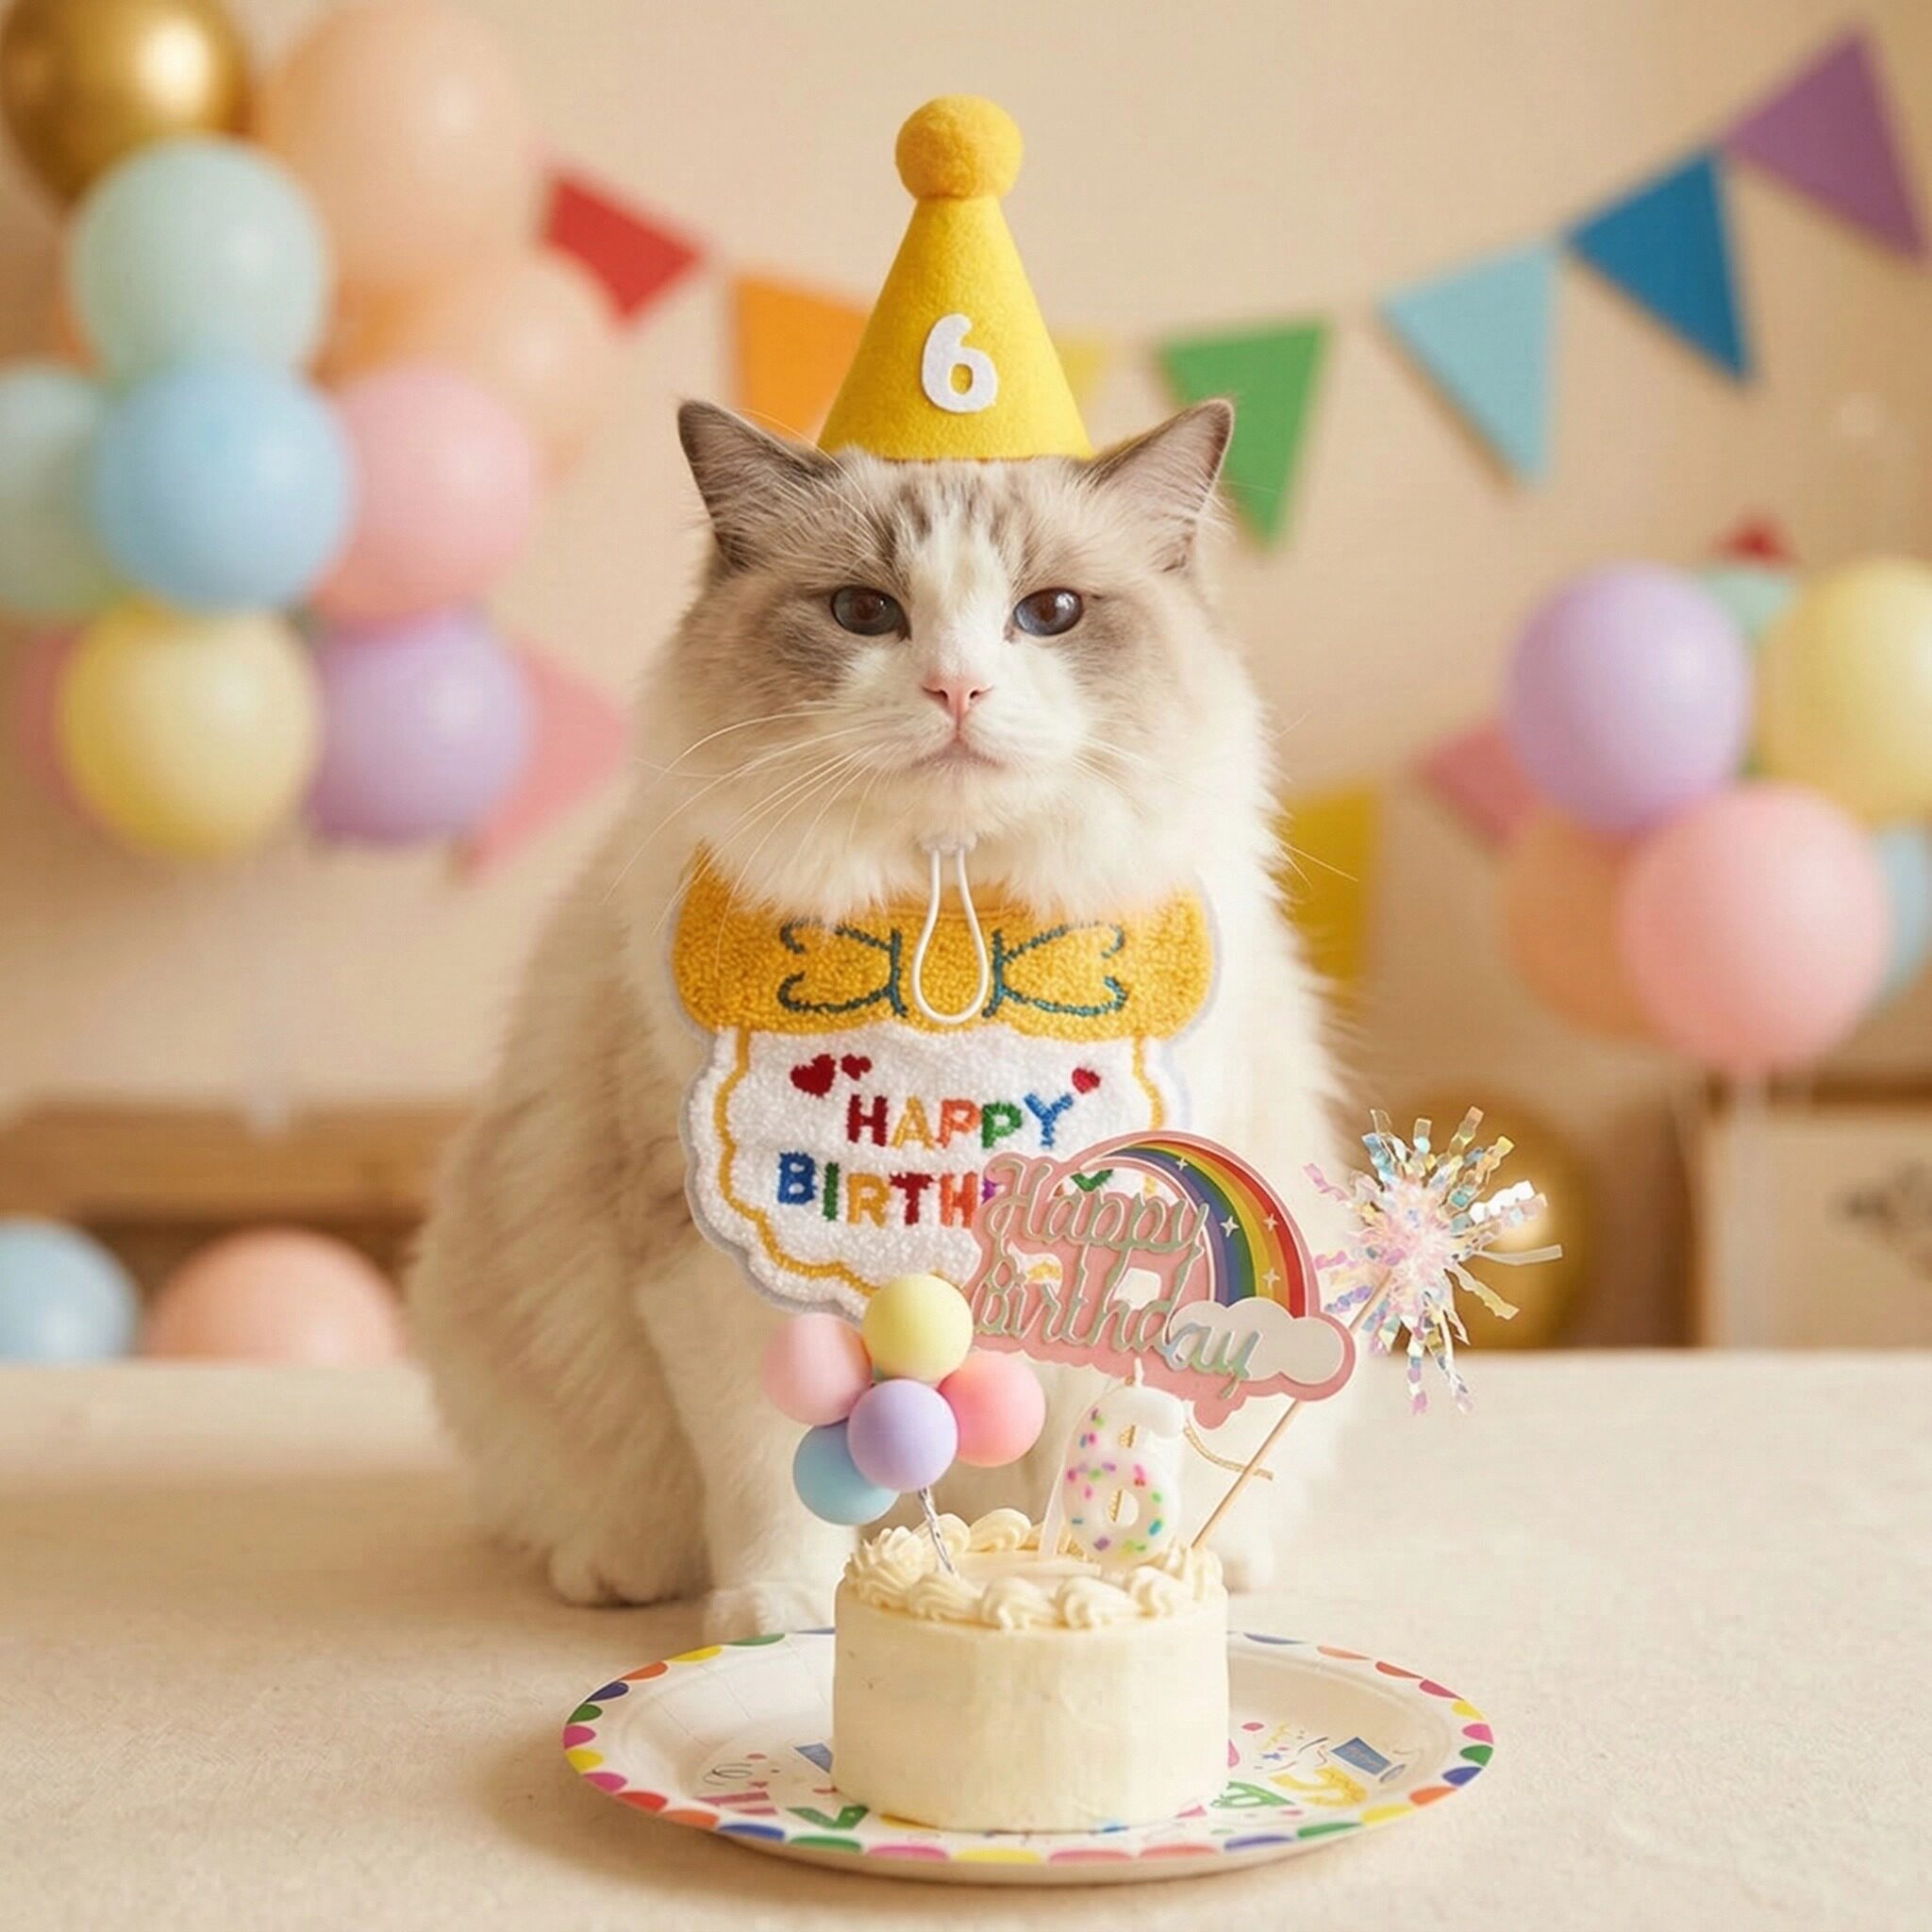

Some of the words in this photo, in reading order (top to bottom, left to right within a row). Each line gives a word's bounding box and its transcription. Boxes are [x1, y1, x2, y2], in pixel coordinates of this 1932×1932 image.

[921, 312, 999, 413] 6
[847, 1092, 1074, 1148] HAPPY
[776, 1151, 1115, 1227] BIRTH
[985, 1158, 1210, 1253] Happy
[972, 1241, 1263, 1400] Birthday
[1063, 1387, 1184, 1559] 6
